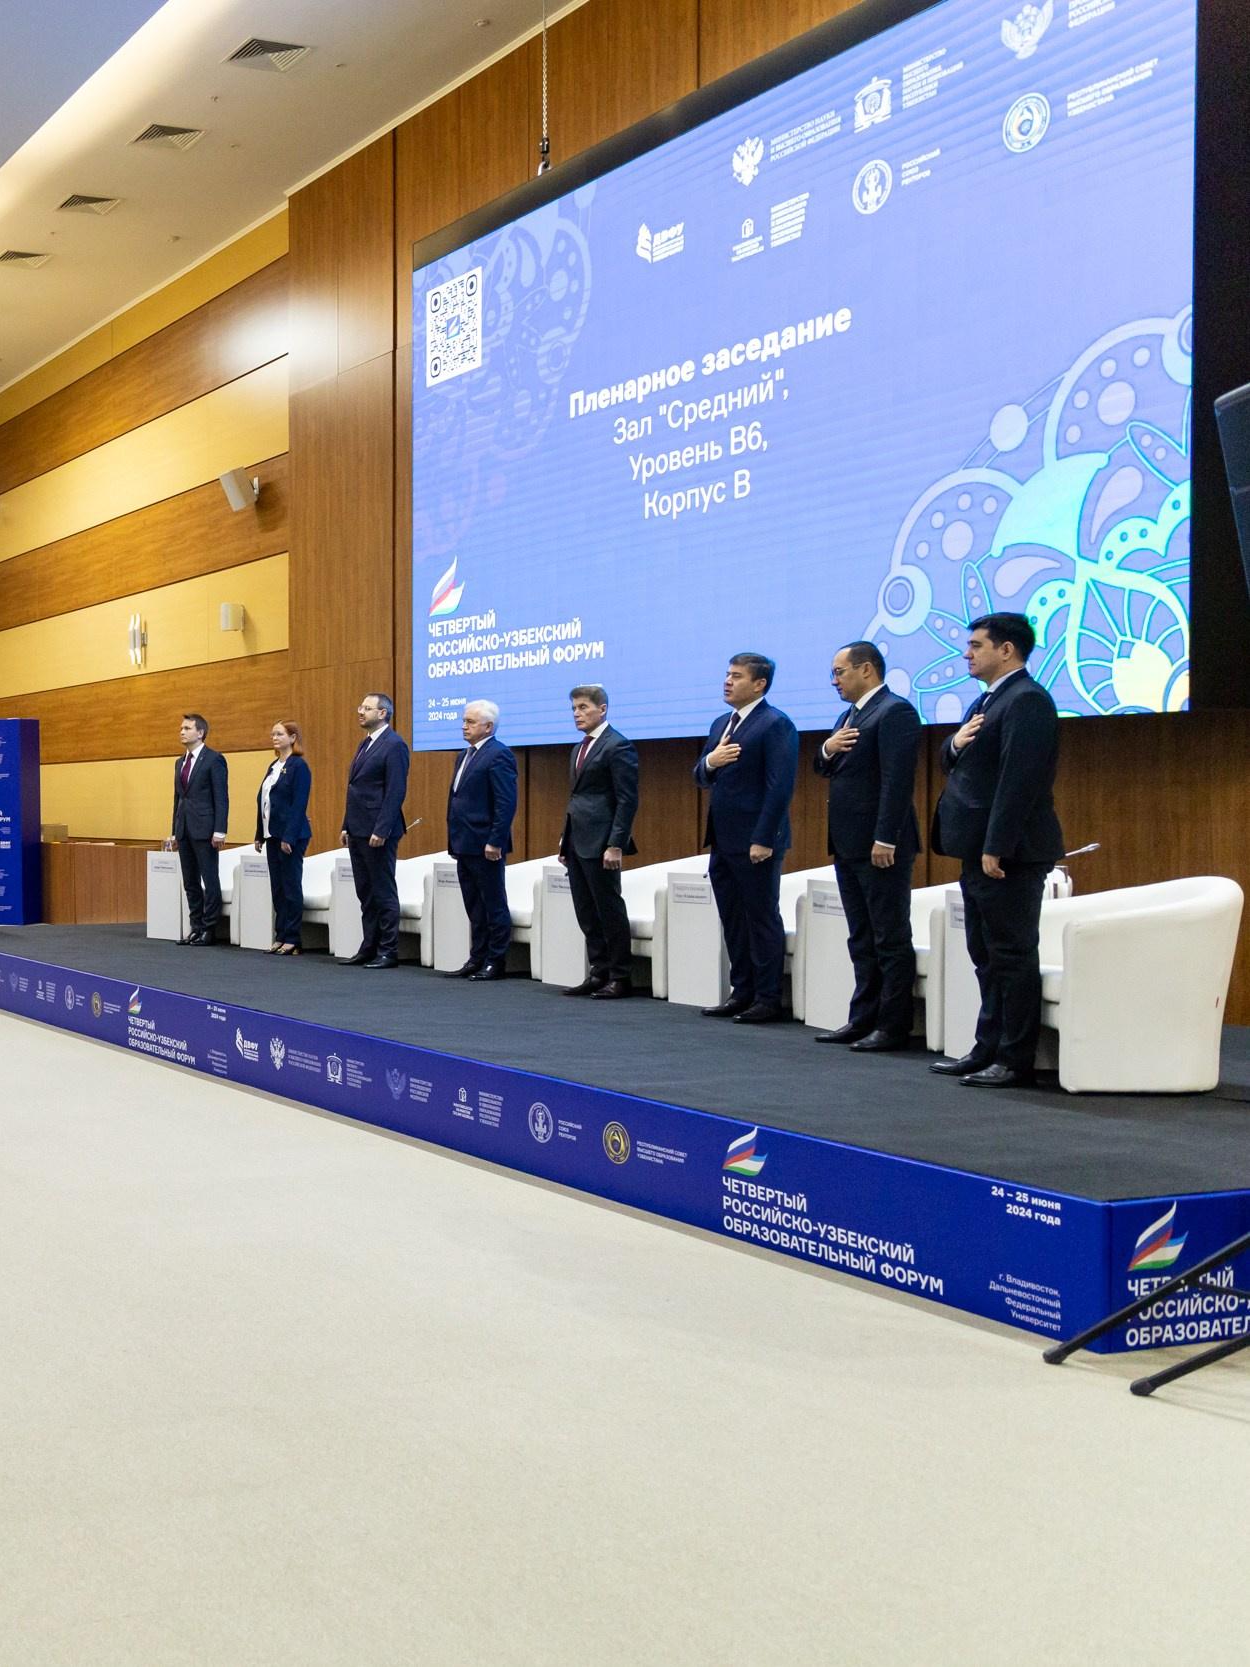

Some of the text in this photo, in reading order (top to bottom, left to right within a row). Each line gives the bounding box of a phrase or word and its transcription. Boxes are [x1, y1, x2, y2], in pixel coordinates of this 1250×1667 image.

[569, 307, 852, 418] Пленарное заседание
[613, 368, 789, 445] Зал "Средний",
[628, 421, 768, 485] Уровень В6,
[644, 469, 751, 519] Корпус В
[428, 609, 496, 638] ЧЕТВЕРТЫЙ
[428, 617, 582, 659] РОССИЙСКО-УЗБЕКСКИЙ
[428, 641, 604, 679] ОБРАЗОВАТЕЛЬНЫЙ ФОРУМ
[428, 699, 436, 708] 24
[442, 698, 449, 707] 25
[428, 711, 458, 721] 2024 года
[128, 1015, 156, 1030] ЧЕТВЕРТЫЙ
[128, 1026, 188, 1051] РОССИЙСКО-УЗБЕКСКИЙ
[128, 1037, 176, 1060] ОБРАЗОВАТЕЛЬНЫЙ
[176, 1051, 196, 1066] ФОРУМ
[243, 1039, 259, 1051] ДВФУ
[722, 1176, 808, 1213] ЧЕТВЕРТЫЙ
[991, 1186, 1005, 1198] 24
[1015, 1191, 1029, 1203] 25
[1031, 1196, 1061, 1211] июня
[1006, 1203, 1061, 1226] 2024 года
[722, 1195, 915, 1265] РОССИЙСКО-УЗБЕКСКИЙ
[723, 1215, 944, 1296] ОБРАЗОВАТЕЛЬНЫЙ ФОРУМ
[989, 1281, 1061, 1309] Дальневосточный
[1006, 1274, 1061, 1298] Владивосток,
[1005, 1297, 1061, 1321] Федеральный
[1011, 1309, 1061, 1332] Университет
